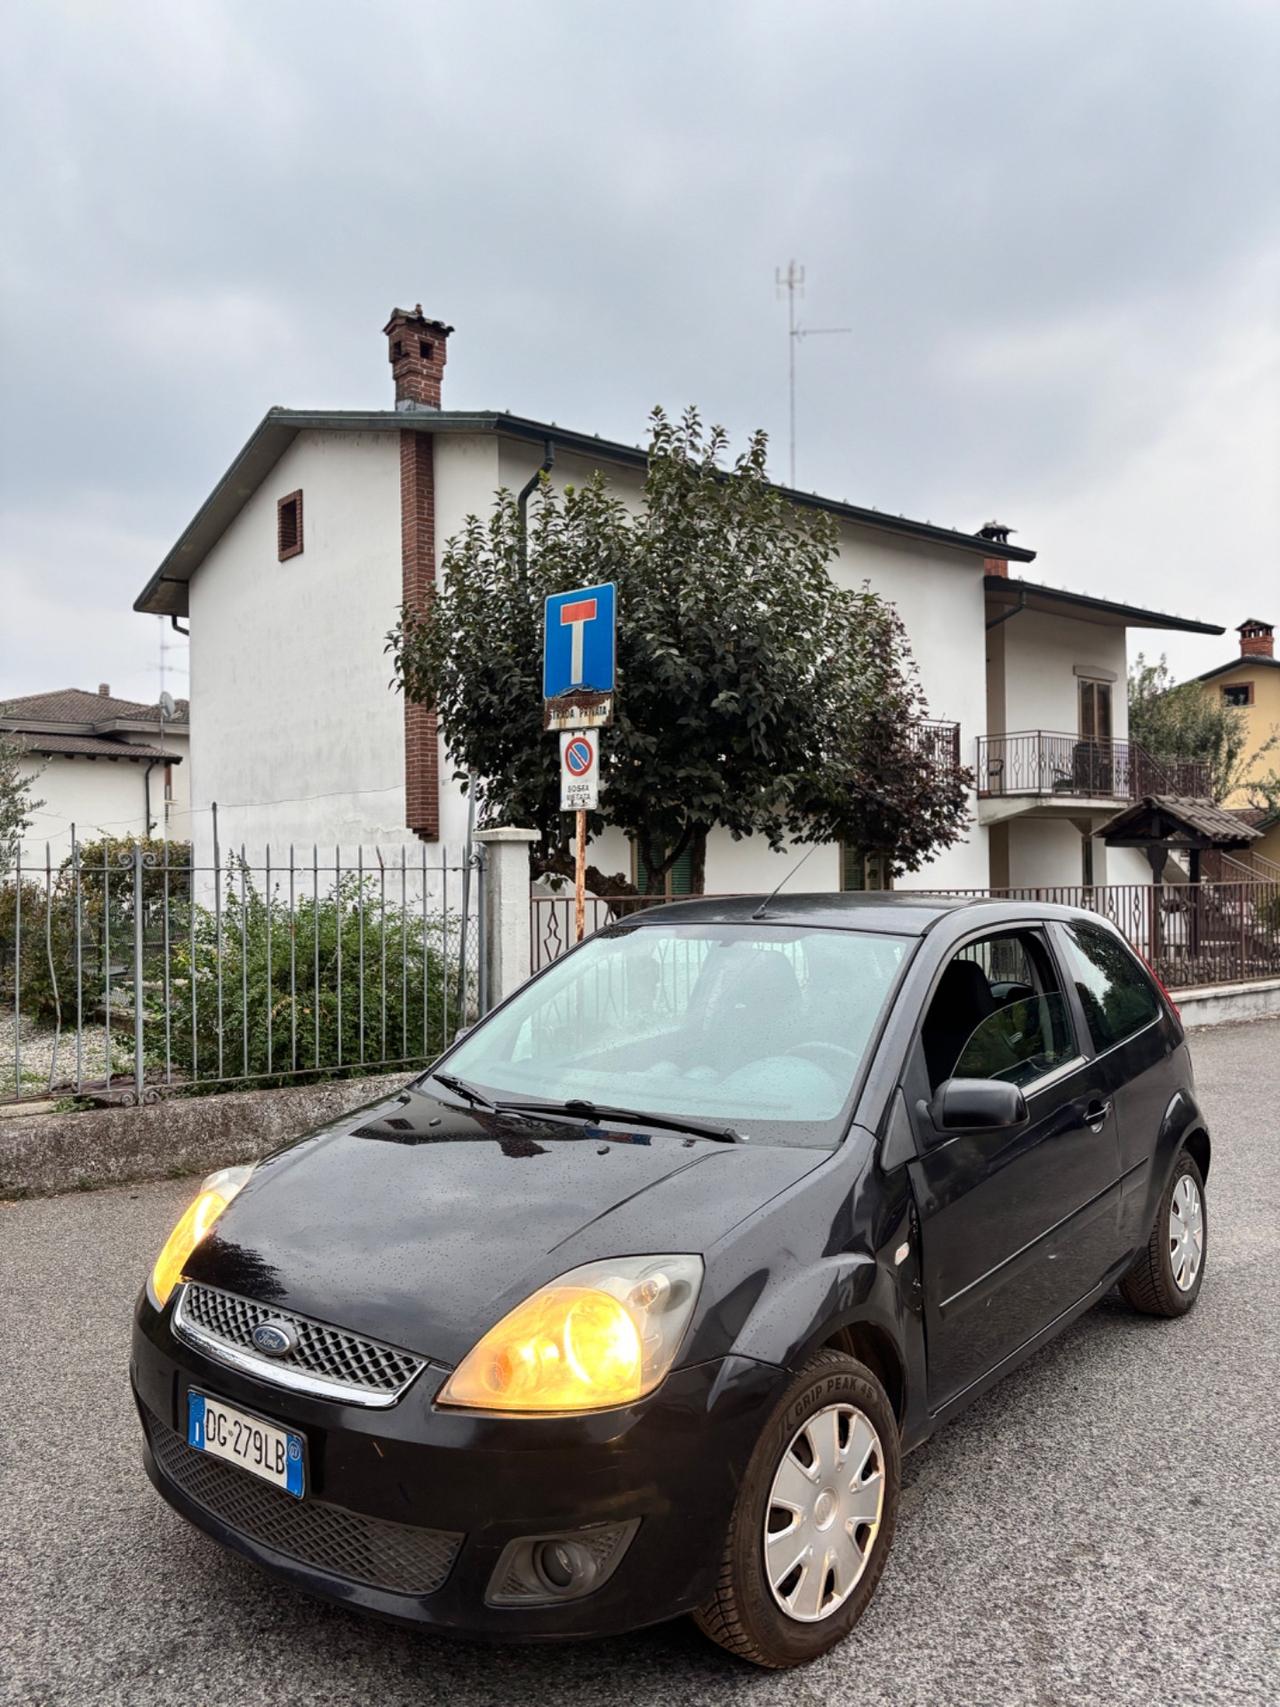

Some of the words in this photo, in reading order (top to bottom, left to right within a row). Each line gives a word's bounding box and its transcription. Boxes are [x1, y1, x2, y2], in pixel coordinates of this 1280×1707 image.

[258, 1330, 281, 1349] Ford
[794, 1385, 823, 1417] GRIP
[826, 1376, 858, 1393] PEAK
